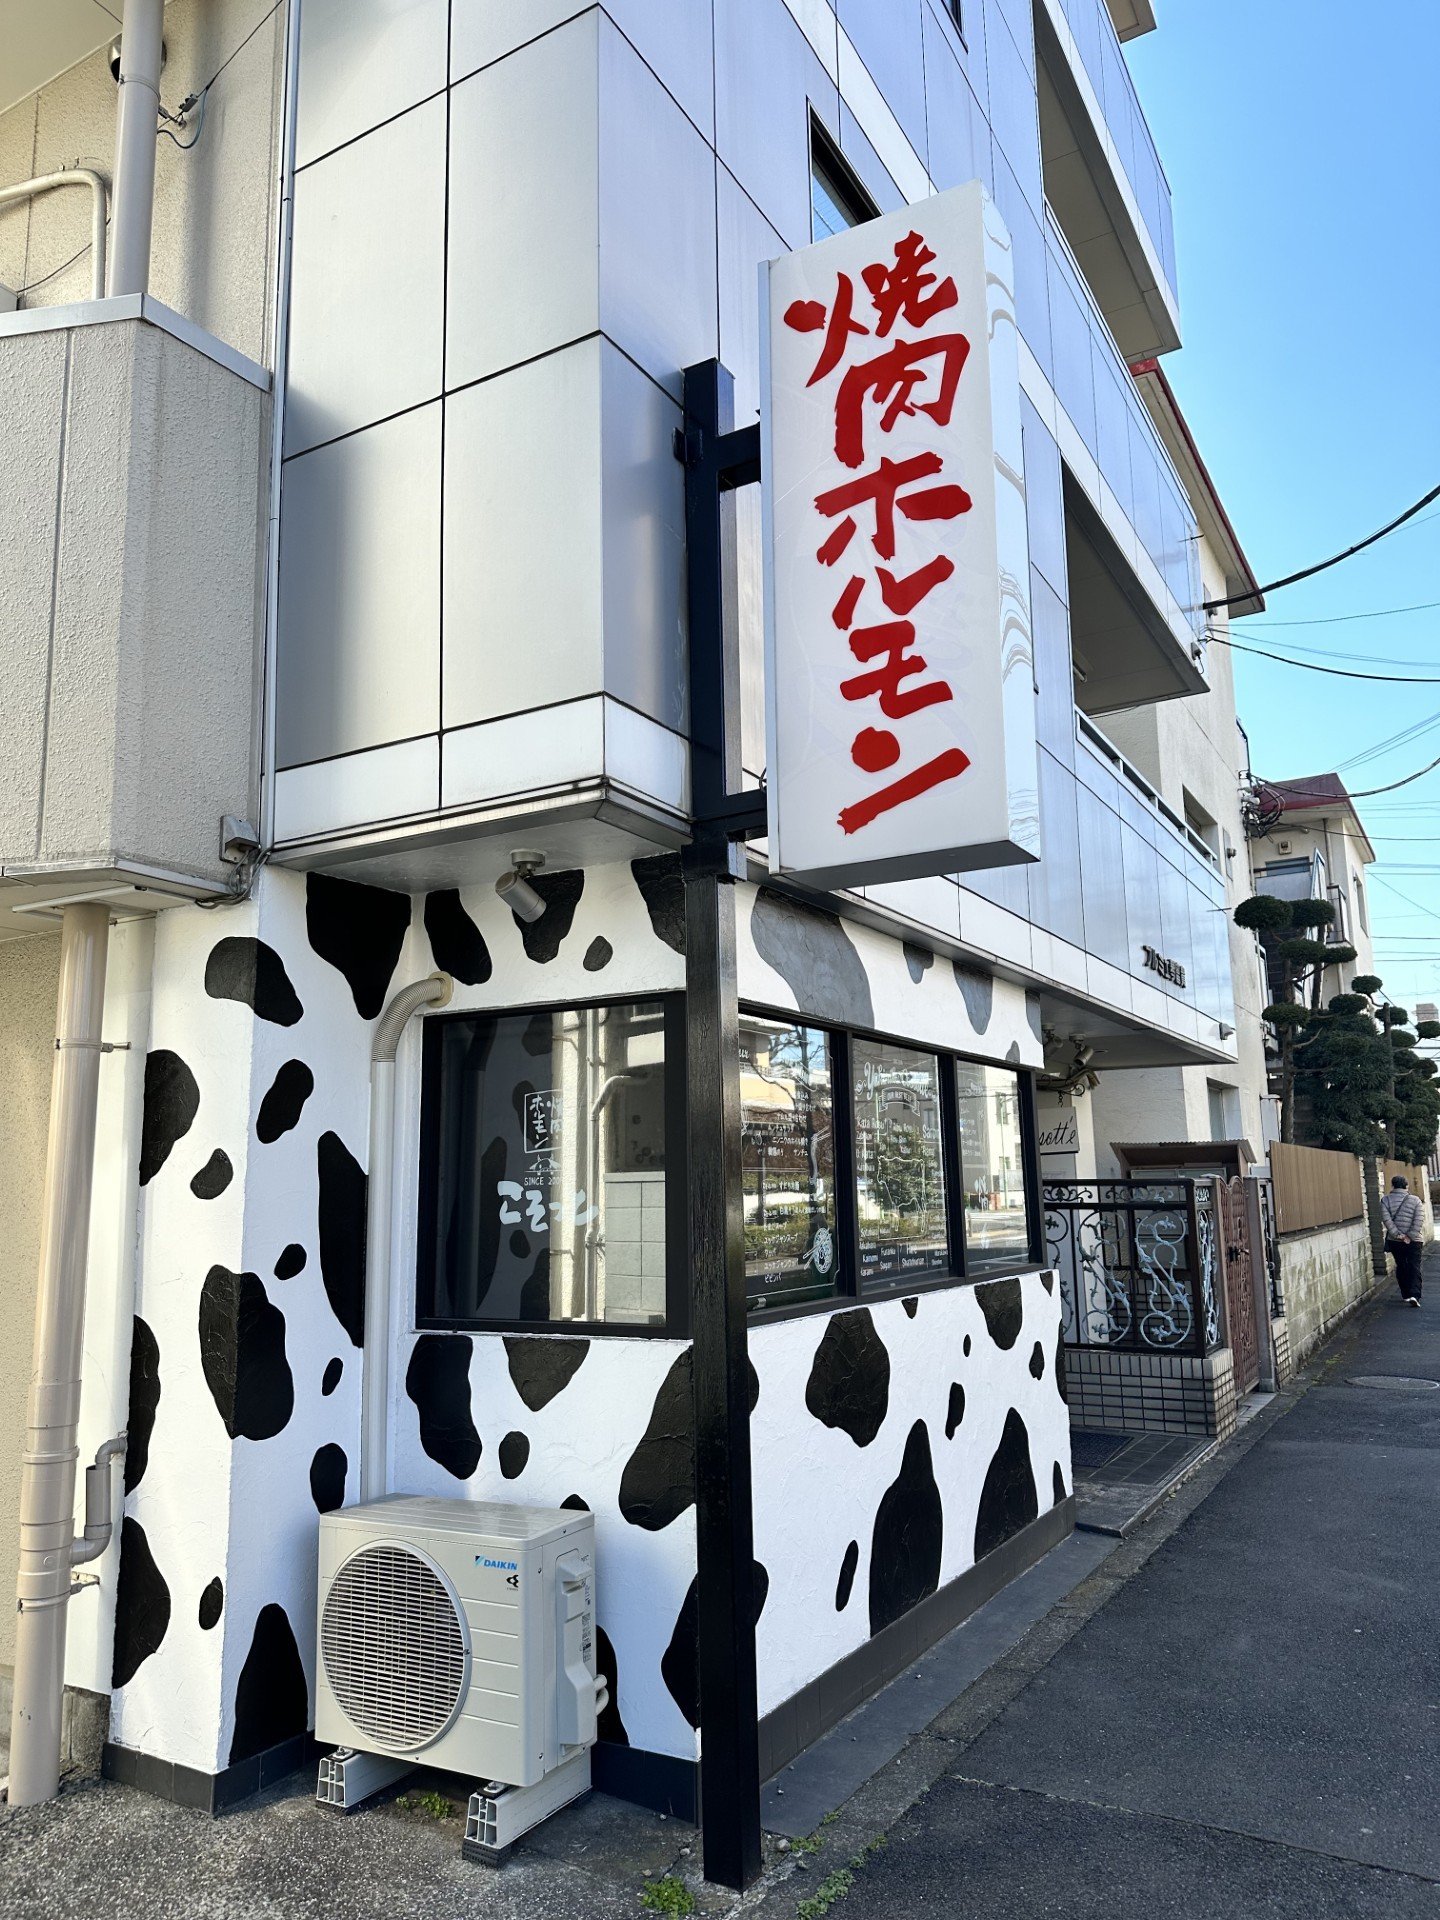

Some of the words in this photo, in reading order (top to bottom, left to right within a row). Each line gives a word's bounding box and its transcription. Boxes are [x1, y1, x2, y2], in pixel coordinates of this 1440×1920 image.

[783, 229, 974, 836] 焼肉ホルモン
[529, 1094, 549, 1149] ホルモン
[523, 1176, 545, 1186] SINCE
[484, 1559, 518, 1571] DAIKIN
